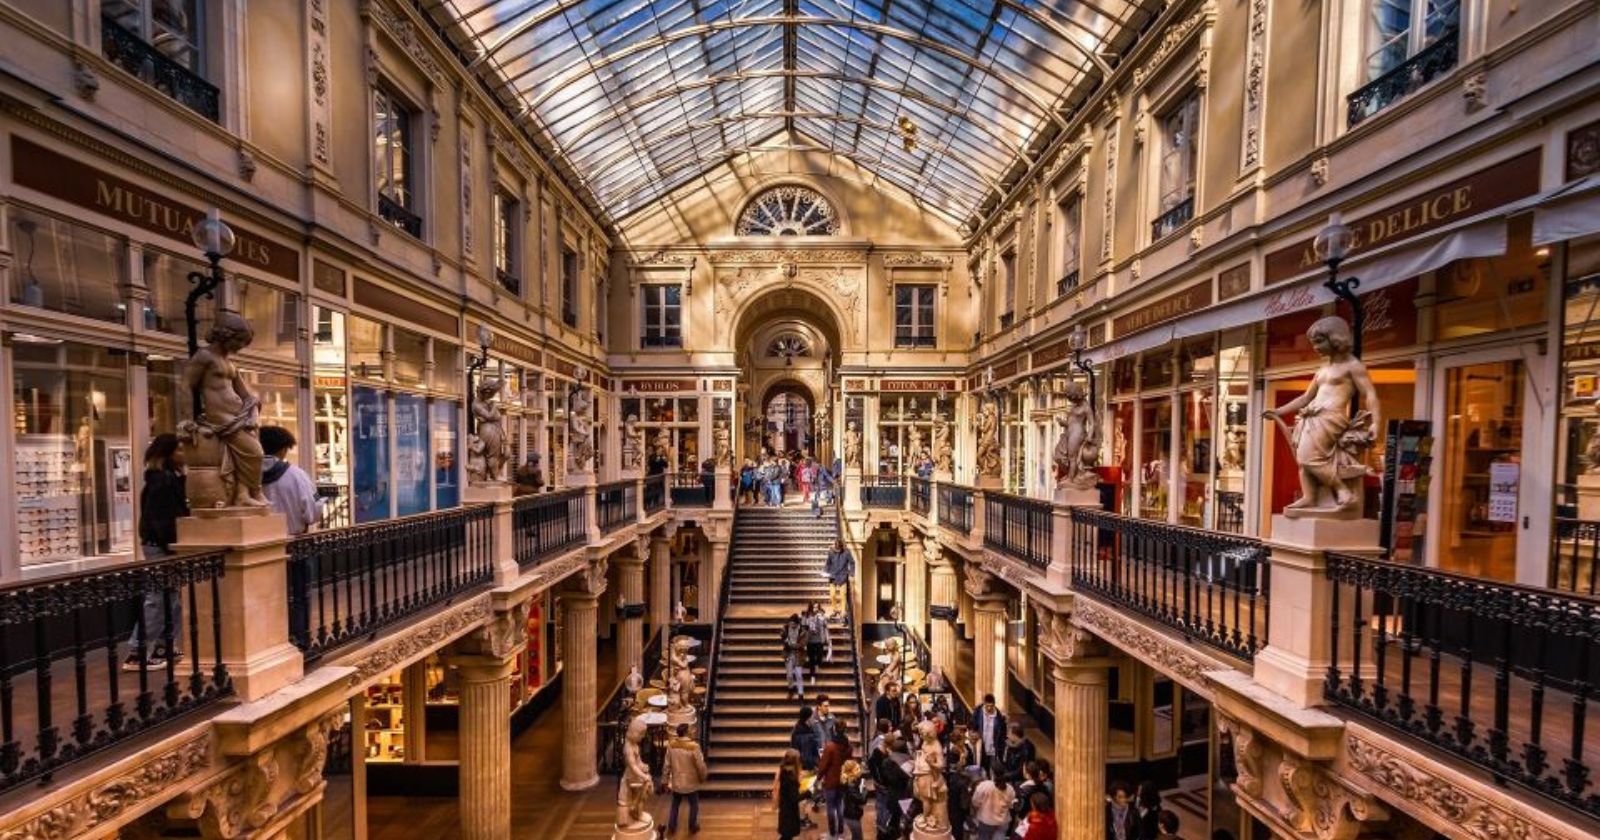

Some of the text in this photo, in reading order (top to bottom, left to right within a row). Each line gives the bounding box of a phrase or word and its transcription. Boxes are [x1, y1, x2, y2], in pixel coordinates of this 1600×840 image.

[96, 180, 270, 265] MUTUATES
[1369, 186, 1472, 243] DELICE
[641, 381, 680, 391] BYBLOS
